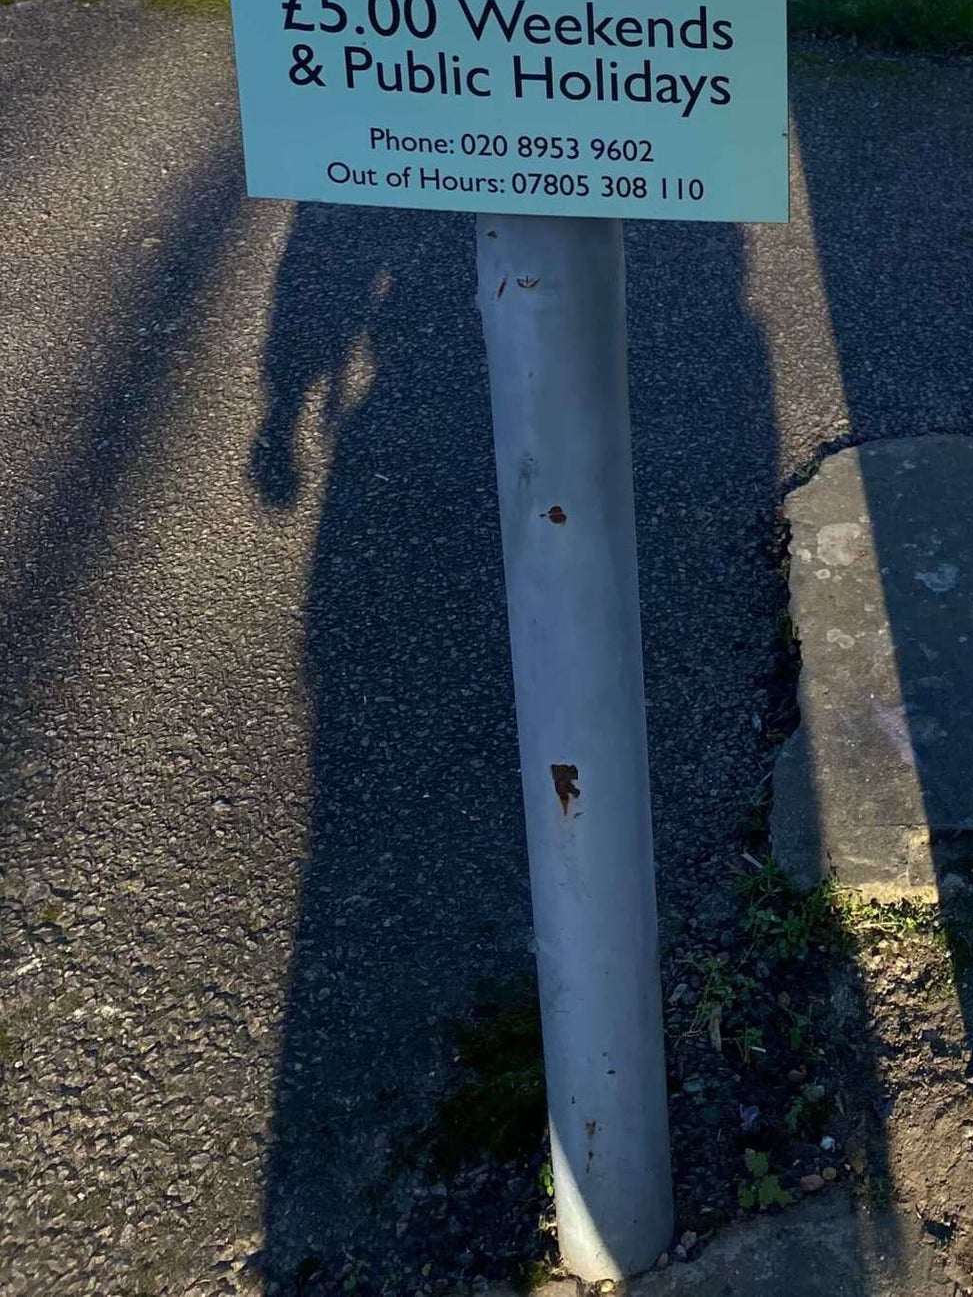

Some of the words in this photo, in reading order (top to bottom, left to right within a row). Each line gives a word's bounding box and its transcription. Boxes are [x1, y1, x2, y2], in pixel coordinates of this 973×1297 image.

[288, 44, 327, 89] &
[344, 45, 492, 98] Public
[512, 55, 731, 118] Holidays
[370, 127, 455, 156] Phone:
[461, 133, 508, 157] 020
[518, 137, 580, 161] 8953
[590, 139, 655, 163] 9602
[327, 162, 378, 188] Out
[388, 164, 416, 189] of
[420, 167, 505, 194] Hours:
[512, 172, 590, 197] 07805
[600, 176, 648, 200] 308
[661, 178, 705, 201] 110
